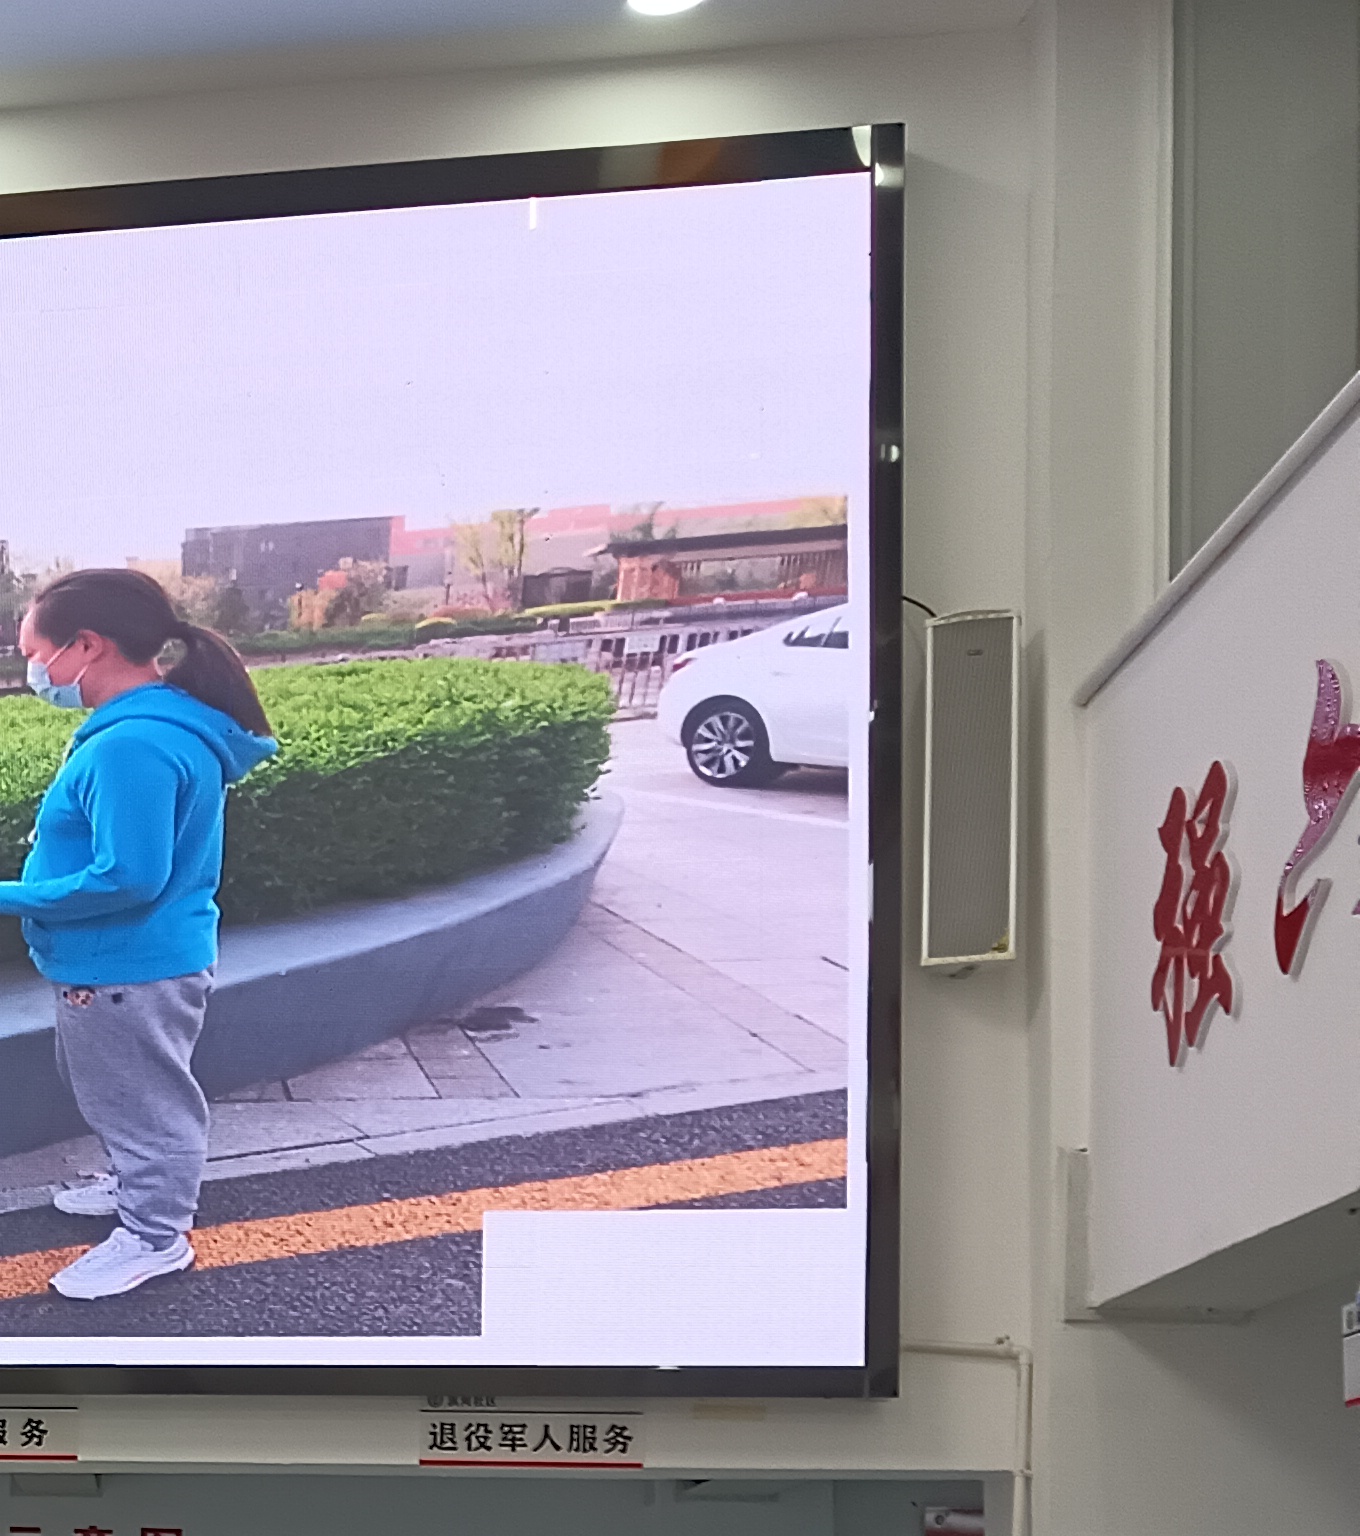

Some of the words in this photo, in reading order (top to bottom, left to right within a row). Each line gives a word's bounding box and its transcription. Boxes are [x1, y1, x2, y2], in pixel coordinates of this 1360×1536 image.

[428, 1421, 634, 1454] 退役军人服务
